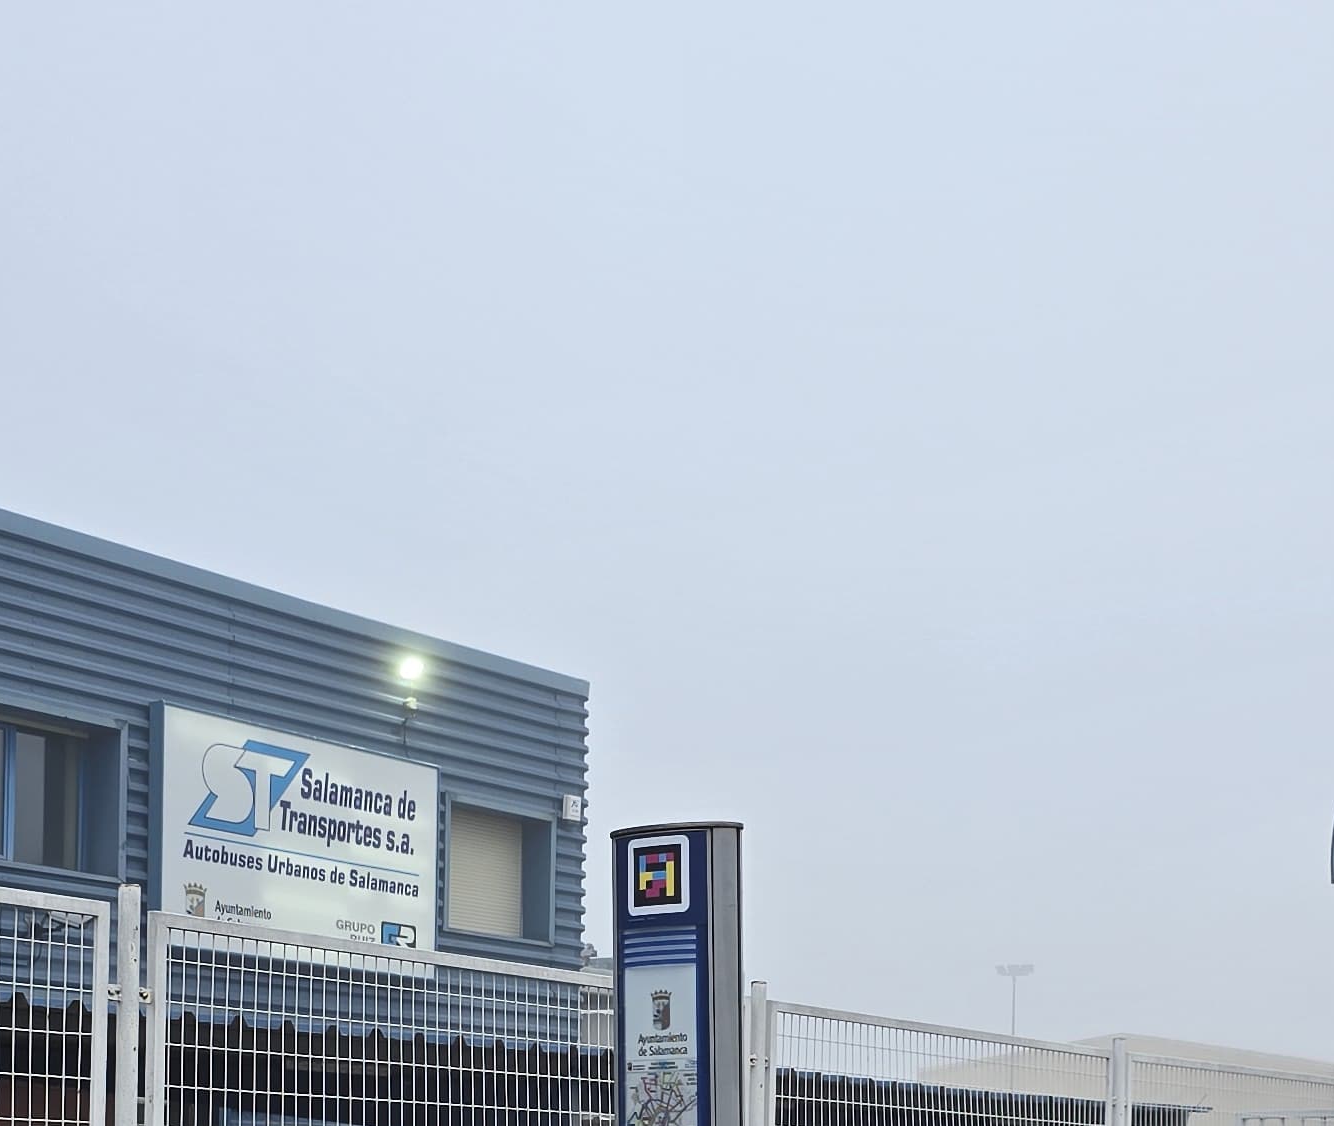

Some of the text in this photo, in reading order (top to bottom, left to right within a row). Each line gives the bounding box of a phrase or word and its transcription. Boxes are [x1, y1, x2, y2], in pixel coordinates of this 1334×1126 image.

[300, 767, 416, 821] Salamanca de
[280, 799, 414, 855] Transportes s.a.
[183, 839, 419, 898] Autobuses Urbanos de Salamanca
[214, 900, 271, 920] Ayuntamiento
[336, 919, 376, 935] GRUPO
